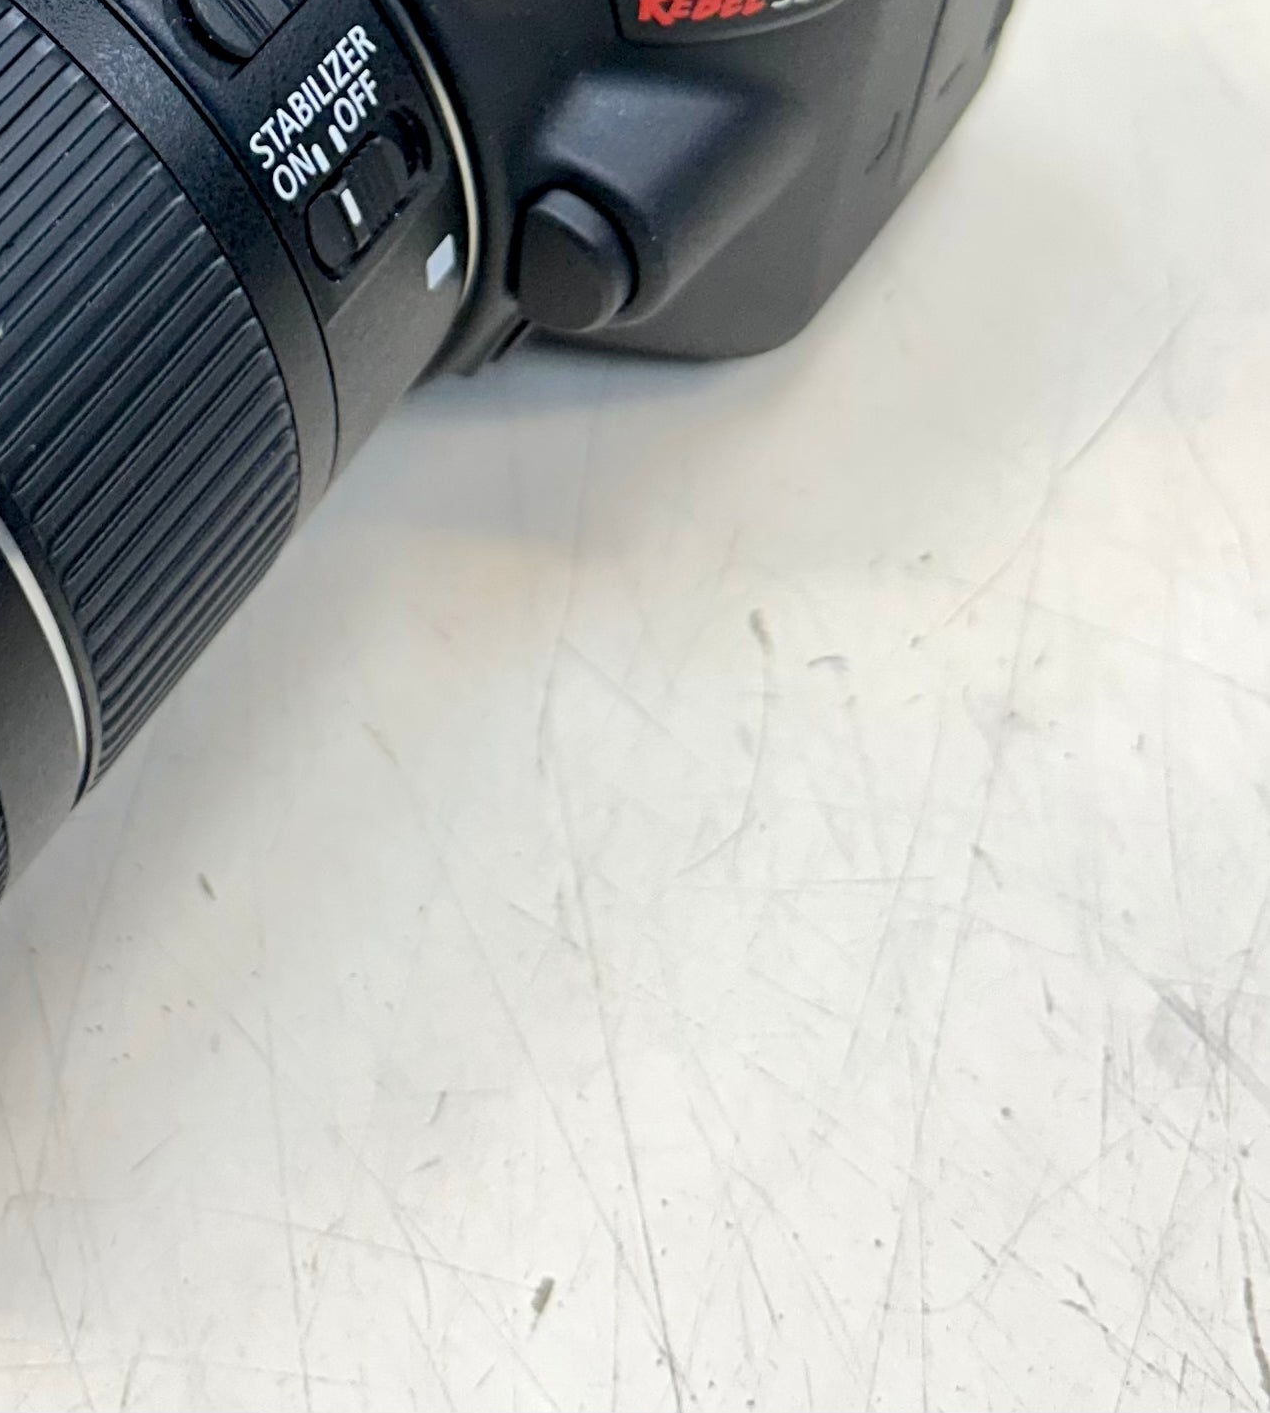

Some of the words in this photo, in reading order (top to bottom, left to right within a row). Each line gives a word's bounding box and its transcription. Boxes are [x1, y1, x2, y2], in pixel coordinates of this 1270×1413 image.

[249, 24, 378, 170] STABILIZER
[272, 147, 318, 202] ON
[333, 68, 378, 134] OFF
